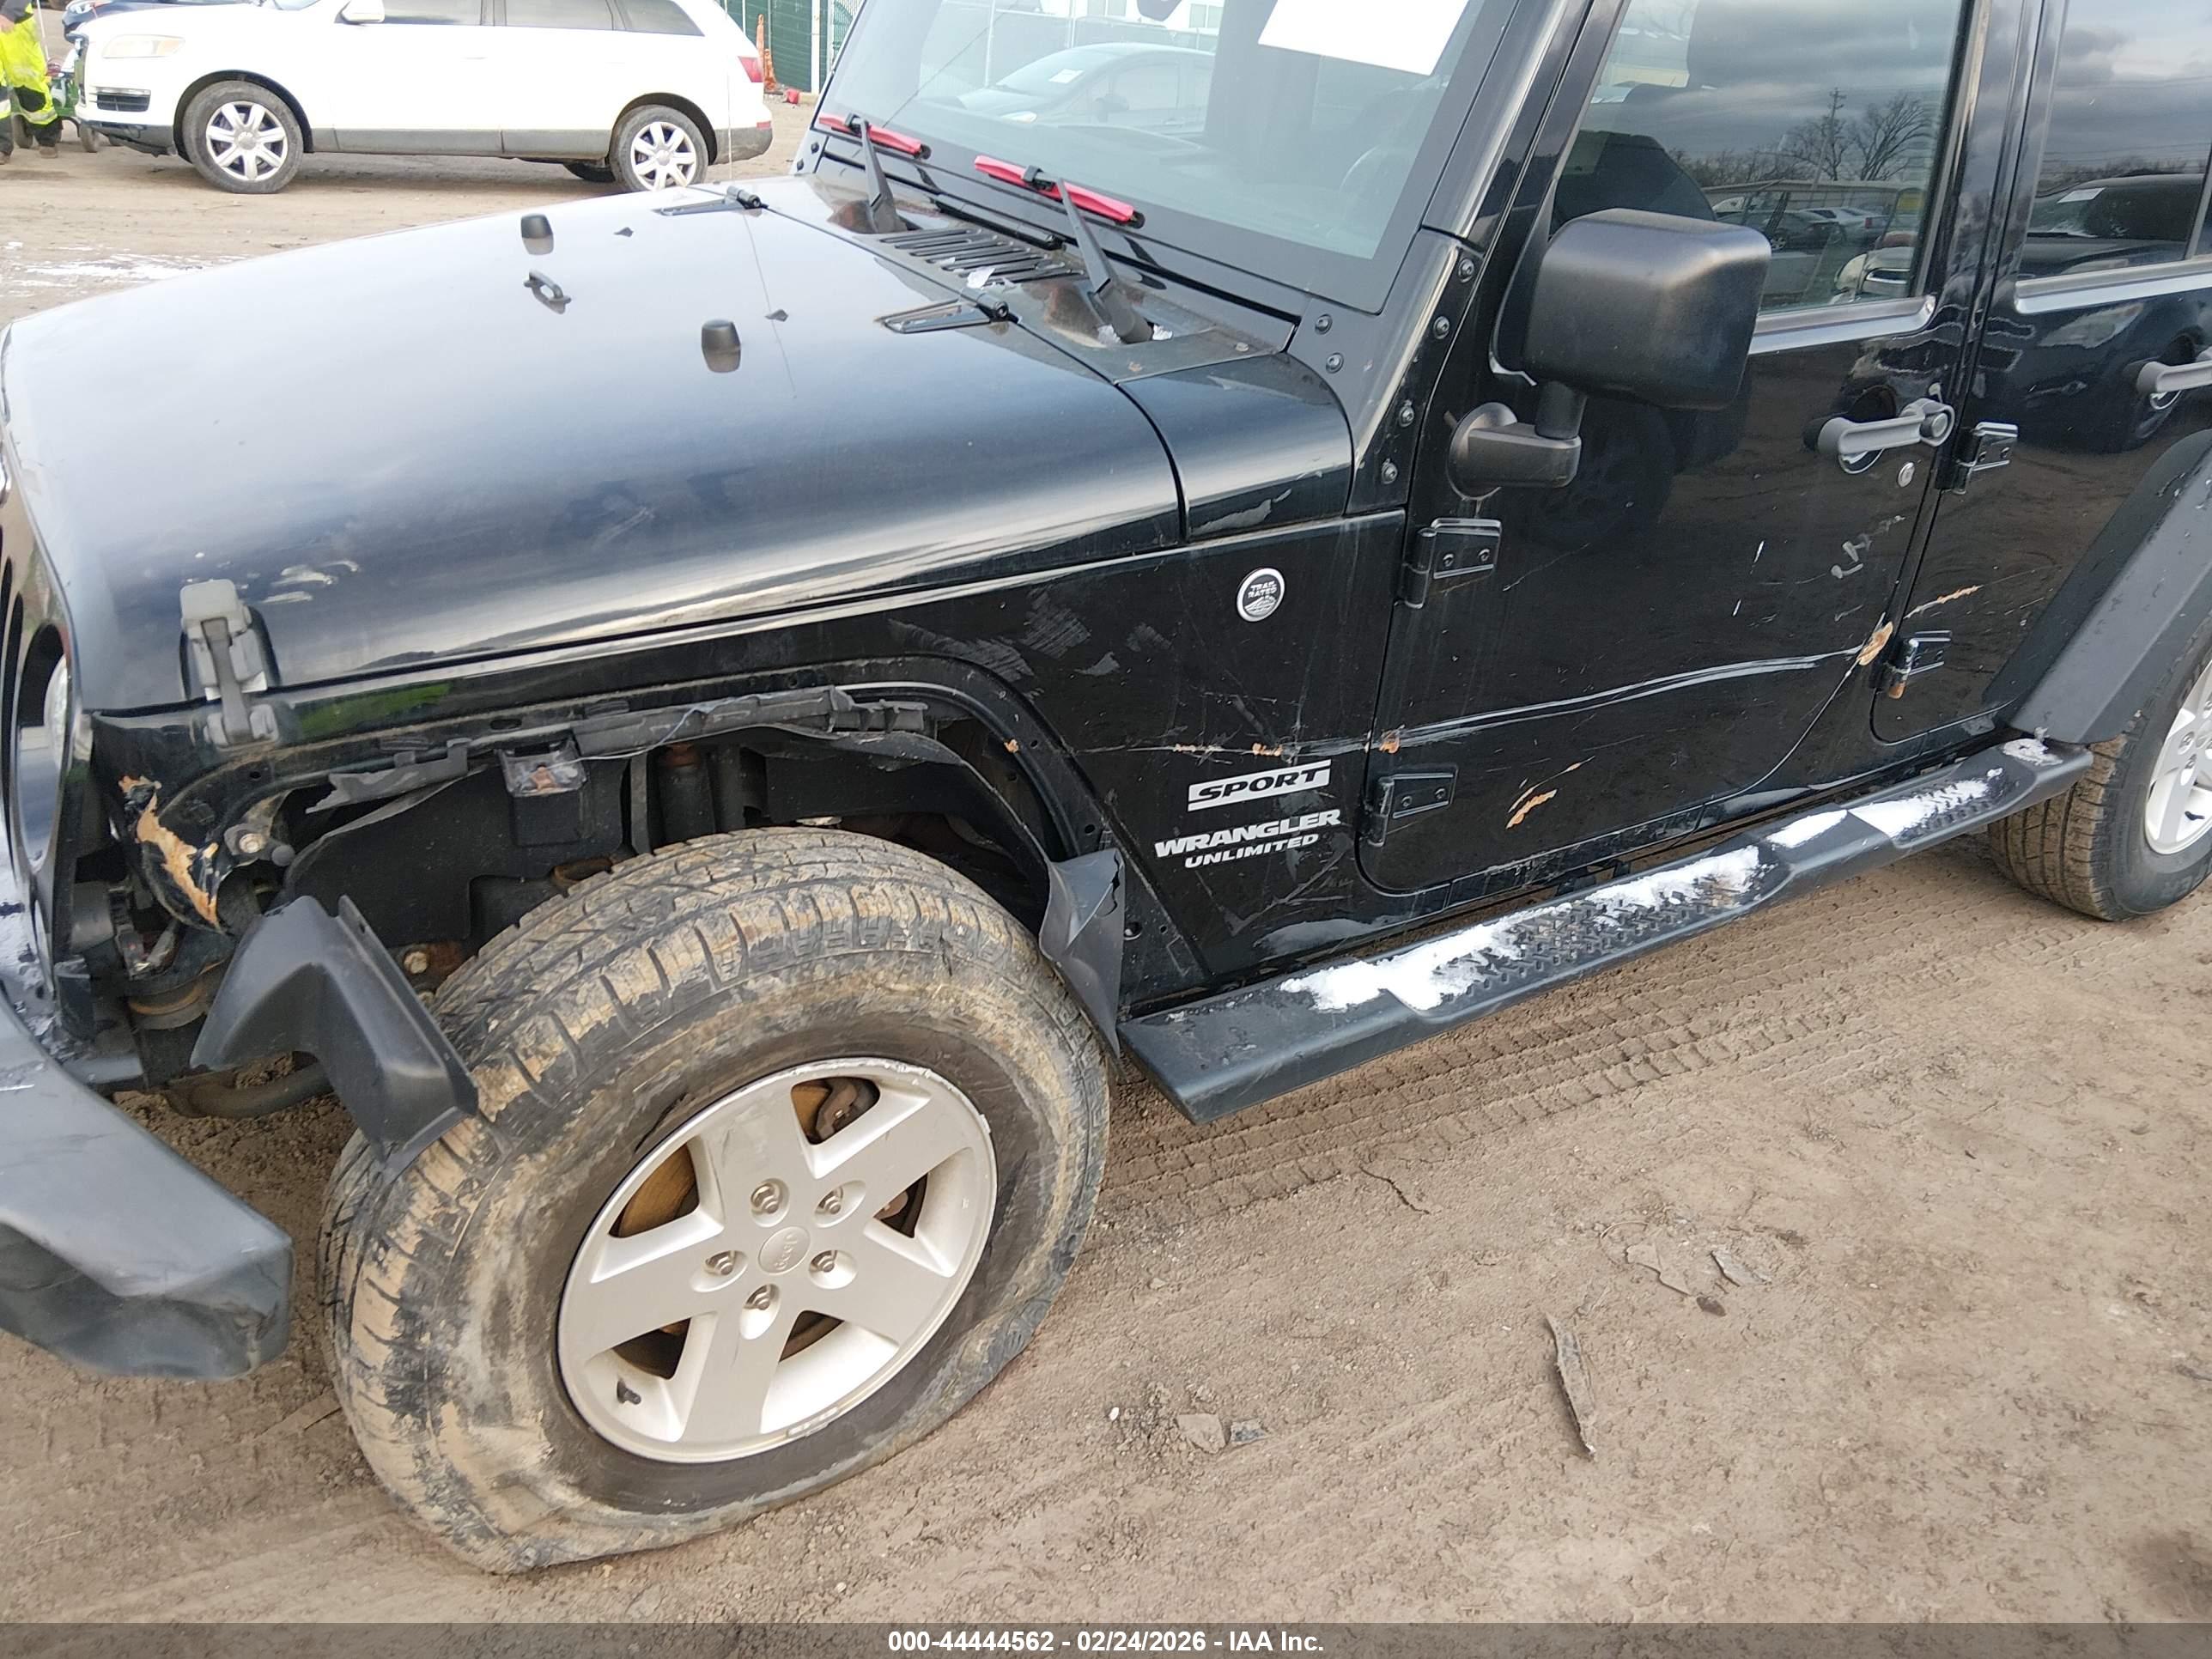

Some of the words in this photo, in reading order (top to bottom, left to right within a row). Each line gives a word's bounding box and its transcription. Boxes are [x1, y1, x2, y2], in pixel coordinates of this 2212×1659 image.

[1198, 769, 1325, 801] SPORT
[1154, 808, 1341, 858] WRANGLER
[1184, 833, 1320, 869] UNLIMITED
